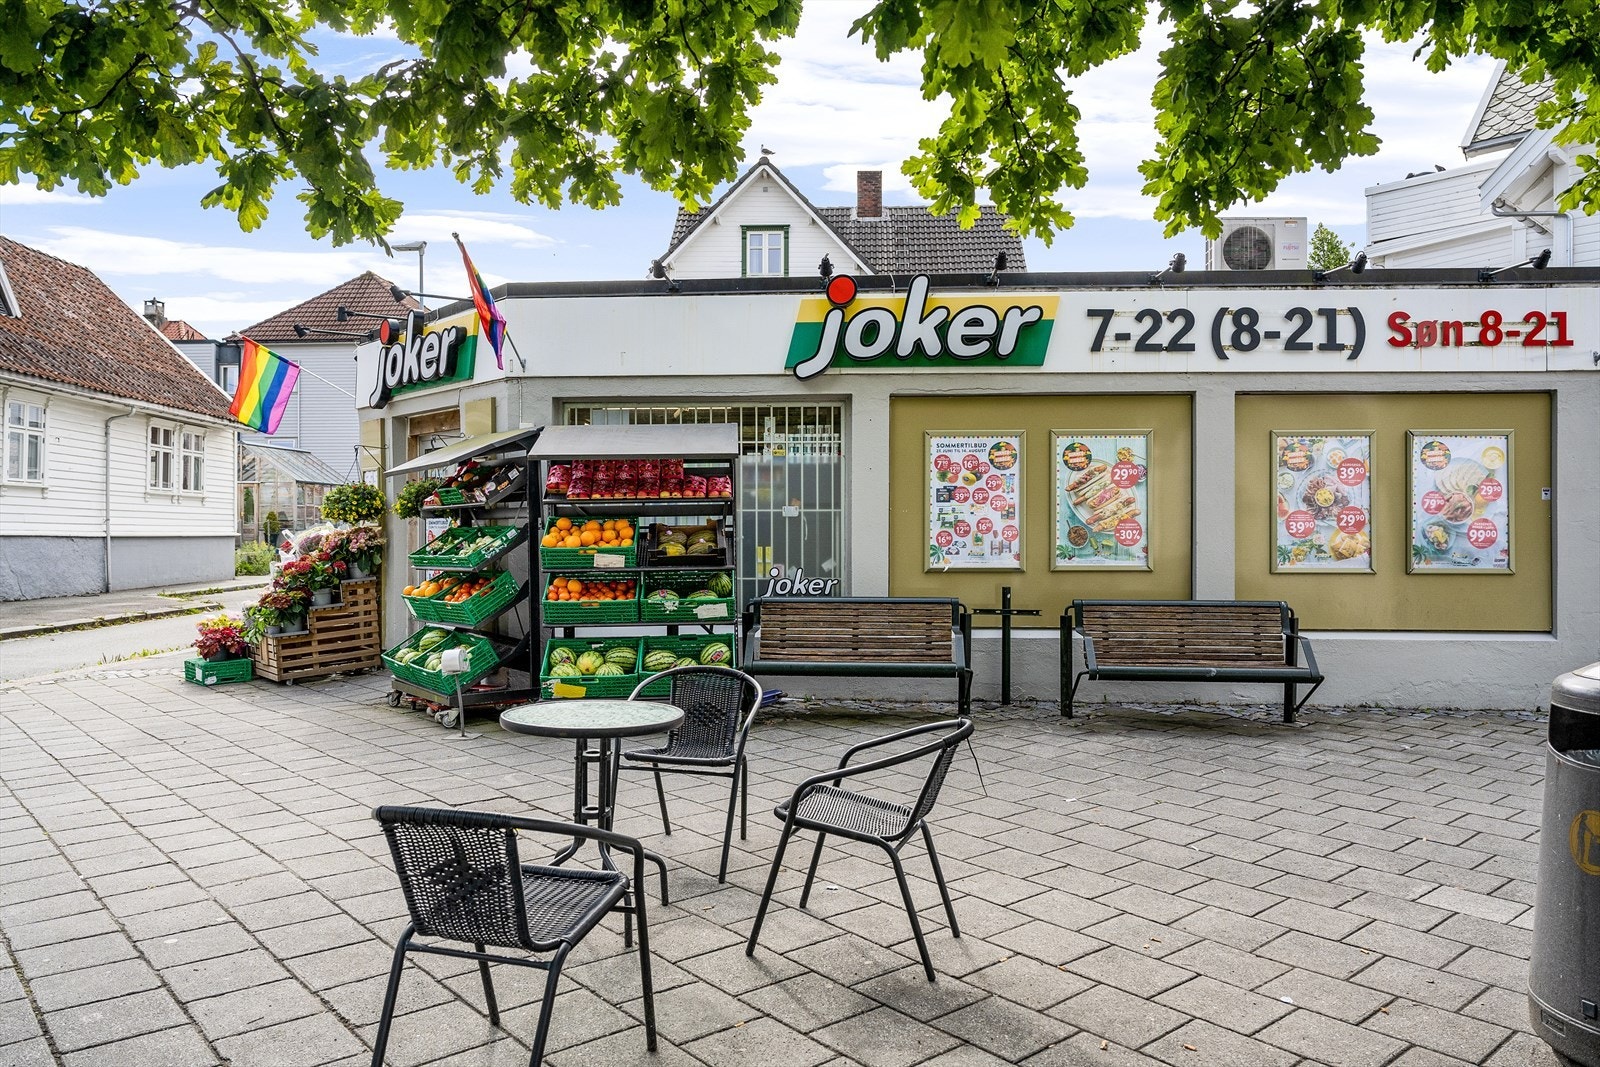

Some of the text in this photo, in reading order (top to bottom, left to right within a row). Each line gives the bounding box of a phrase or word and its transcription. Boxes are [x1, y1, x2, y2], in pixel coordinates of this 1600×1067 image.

[793, 274, 1044, 381] joker
[1087, 306, 1366, 360] 7-22 (8-21)
[1387, 310, 1574, 349] Søn 8-21
[369, 309, 467, 409] joker
[760, 567, 839, 598] joker
